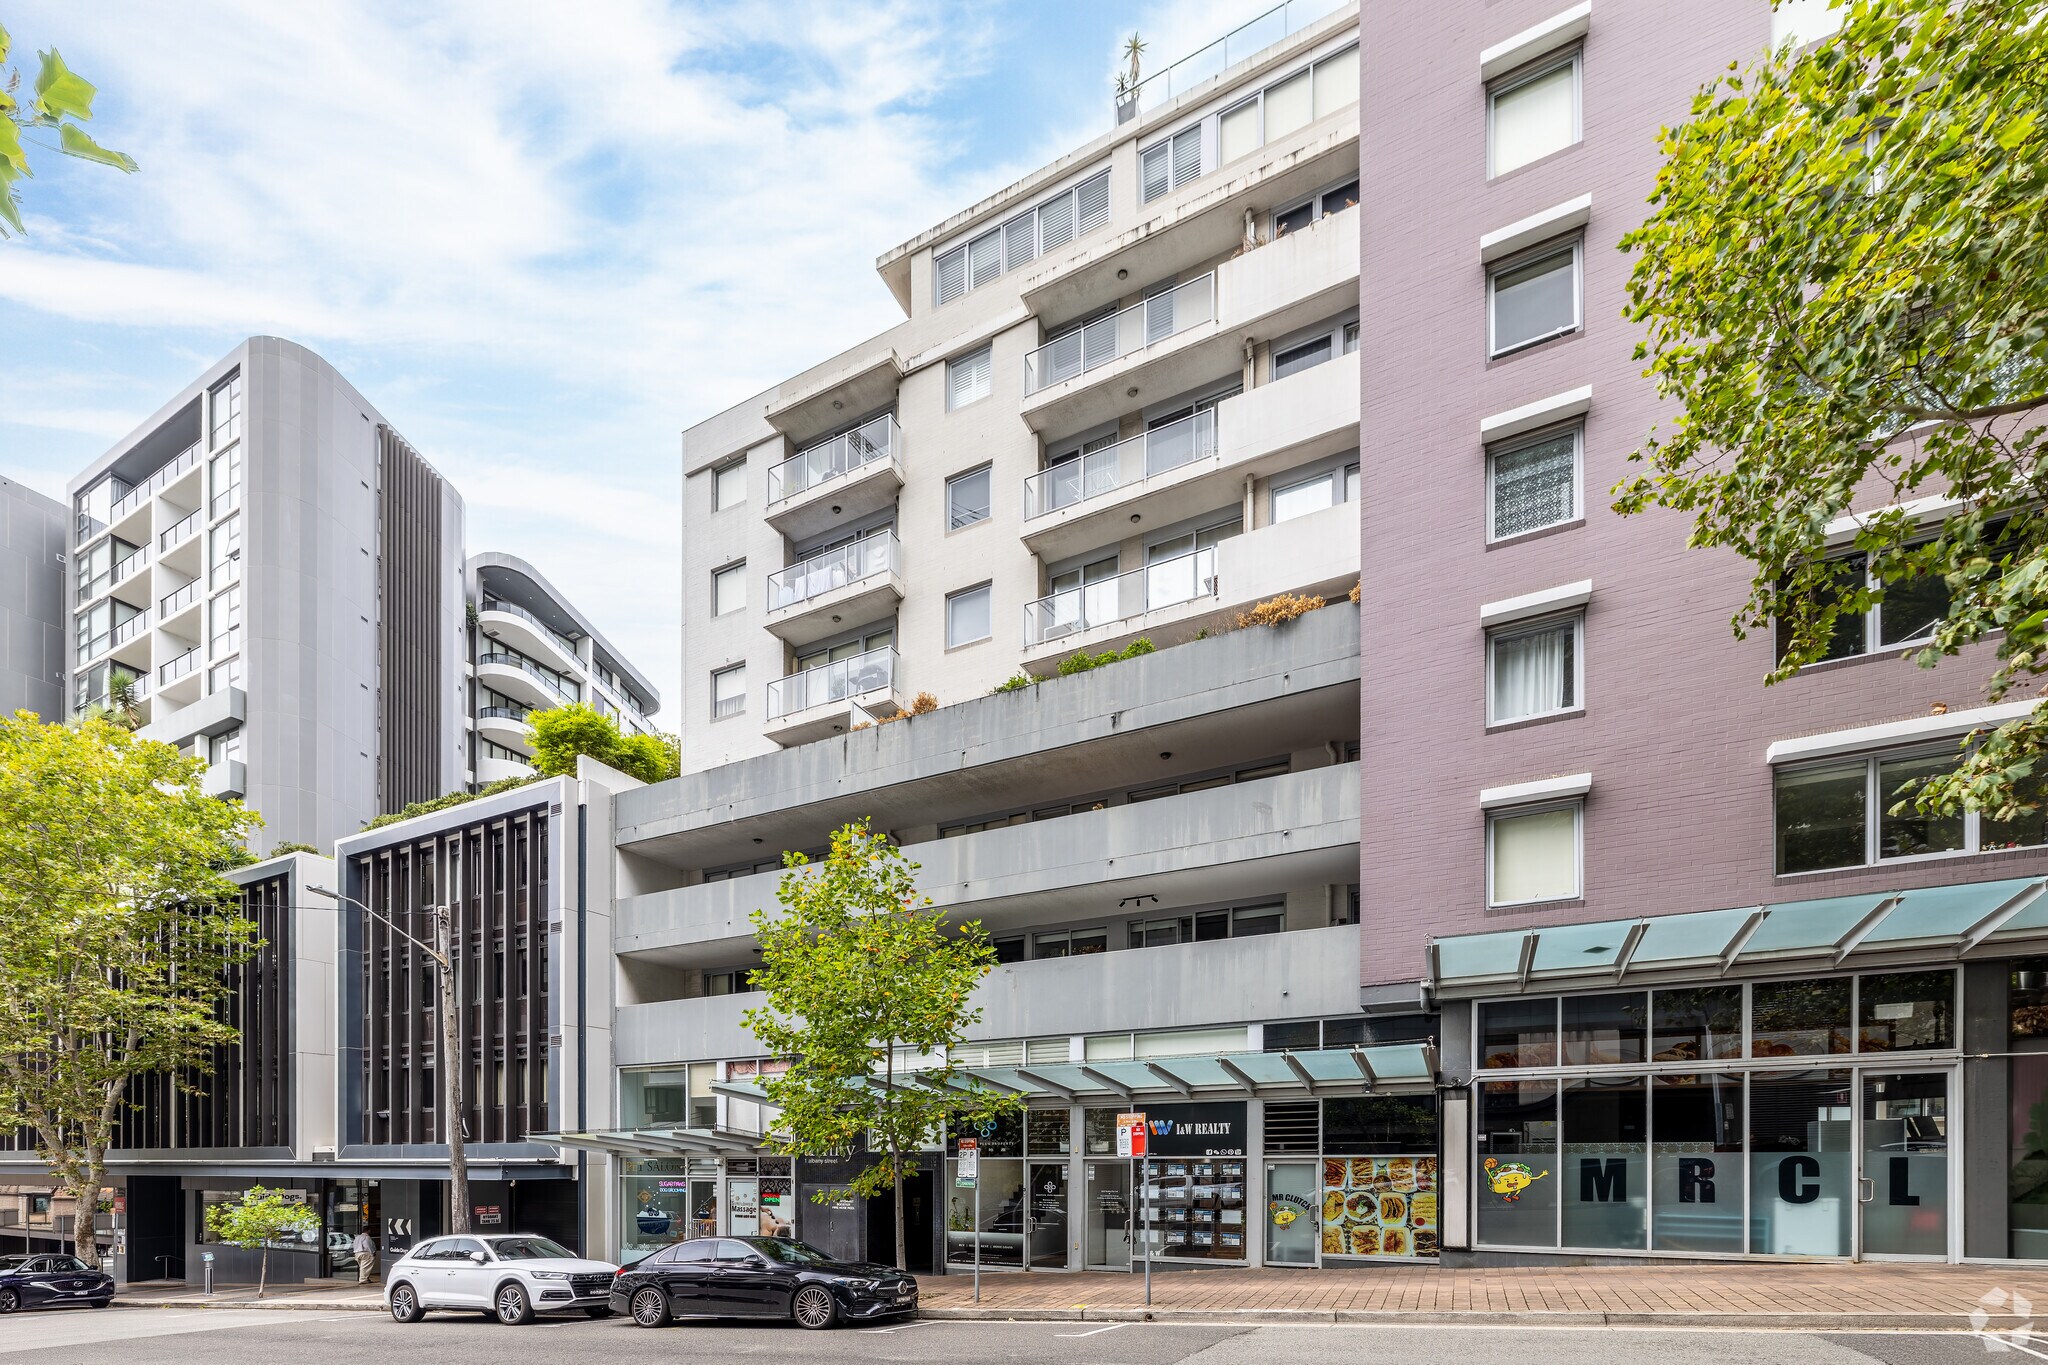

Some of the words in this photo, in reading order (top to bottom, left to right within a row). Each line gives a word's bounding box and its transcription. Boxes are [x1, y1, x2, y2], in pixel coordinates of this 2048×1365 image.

[1120, 1128, 1126, 1136] P
[1195, 1122, 1231, 1134] REALTY
[732, 1206, 757, 1214] Massage
